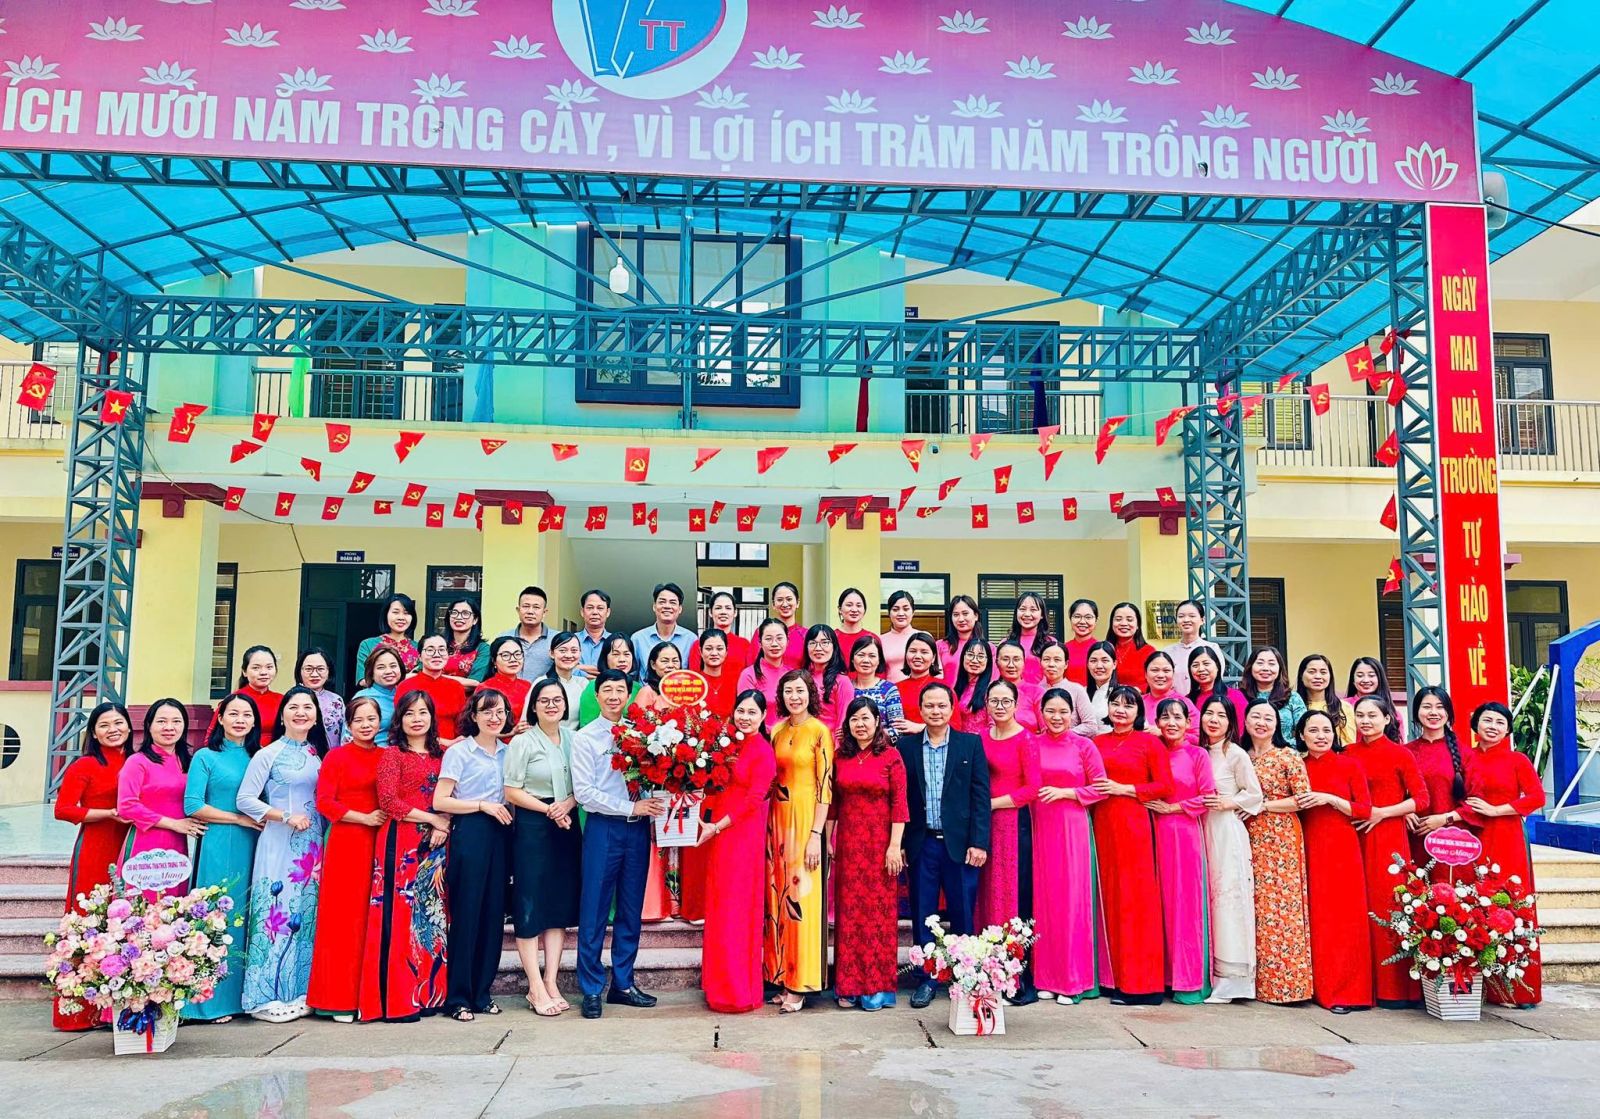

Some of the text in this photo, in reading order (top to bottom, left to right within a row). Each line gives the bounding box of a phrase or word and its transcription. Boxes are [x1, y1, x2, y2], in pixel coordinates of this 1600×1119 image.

[639, 18, 685, 52] TT
[2, 77, 82, 134] ÍCH
[96, 83, 218, 140] MƯỜI
[232, 88, 341, 145] NĂM
[520, 101, 618, 162] CÂY,
[633, 105, 674, 158] VÌ
[689, 112, 754, 172] LỢI
[771, 109, 841, 165] ÍCH
[856, 113, 975, 170] TRĂM
[991, 119, 1088, 175] NĂM
[1102, 119, 1239, 181] TRỒNG
[1252, 130, 1379, 184] NGƯỜI
[1441, 268, 1477, 312] NGÀY
[1450, 335, 1478, 371] MAI
[1451, 390, 1482, 434] NHÀ
[1441, 448, 1497, 495] TRƯỜNG
[1462, 518, 1482, 566] TỰ
[1459, 577, 1488, 622] HÀO
[1467, 633, 1488, 686] VỀ
